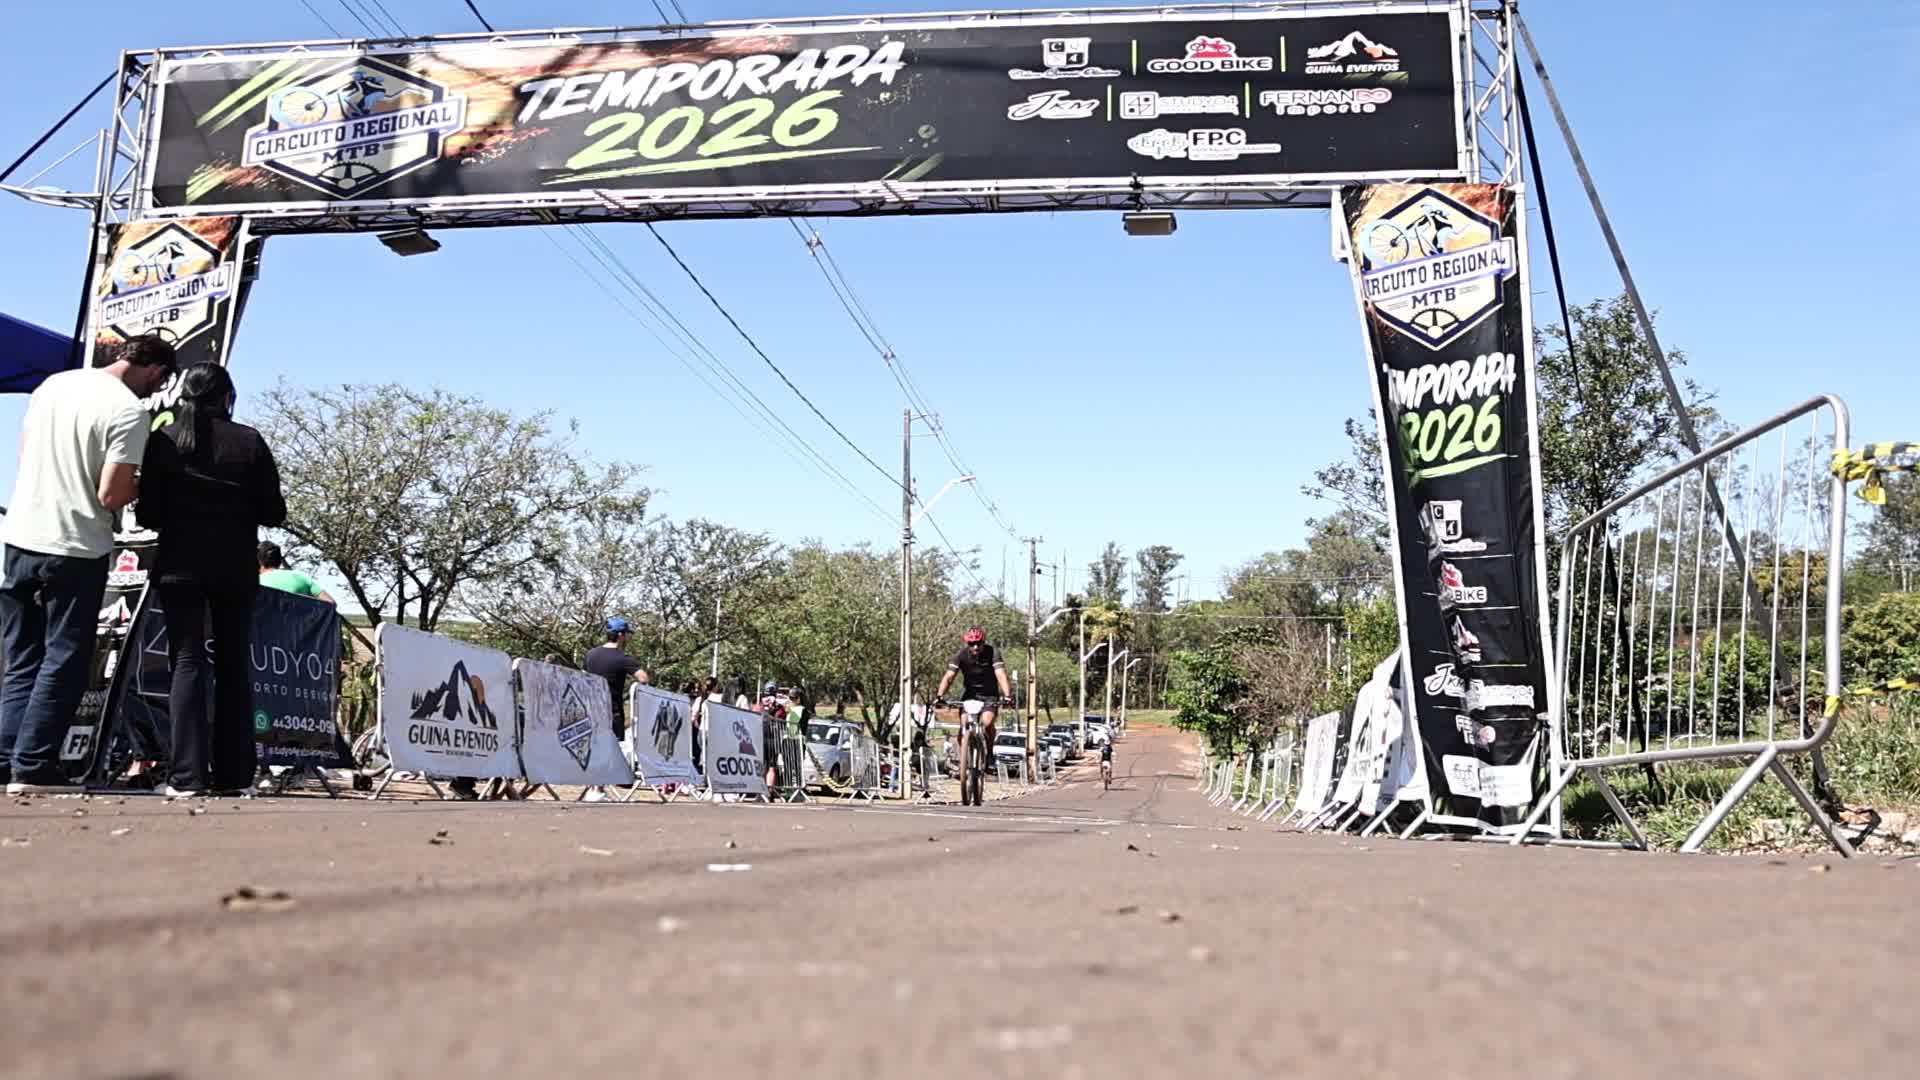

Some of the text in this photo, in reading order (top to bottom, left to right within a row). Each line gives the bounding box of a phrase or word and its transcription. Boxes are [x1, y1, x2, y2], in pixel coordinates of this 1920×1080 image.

[1149, 58, 1270, 71] GOOD BIKE
[1305, 62, 1399, 74] GUINA EVENTOS
[255, 106, 452, 156] CIRCUITO REGIONAL
[565, 91, 844, 170] 2026
[322, 143, 380, 163] MTB
[1367, 266, 1428, 296] IRCUITO
[105, 271, 225, 321] CIRCUITO REGIONAL
[1411, 287, 1457, 309] MTB
[142, 308, 180, 327] MTB
[1383, 352, 1517, 410] MPORADA
[1402, 394, 1501, 463] 2026
[1455, 589, 1485, 600] BIKE
[408, 724, 498, 753] GUINA EVENTOS
[716, 757, 753, 776] GOOD
